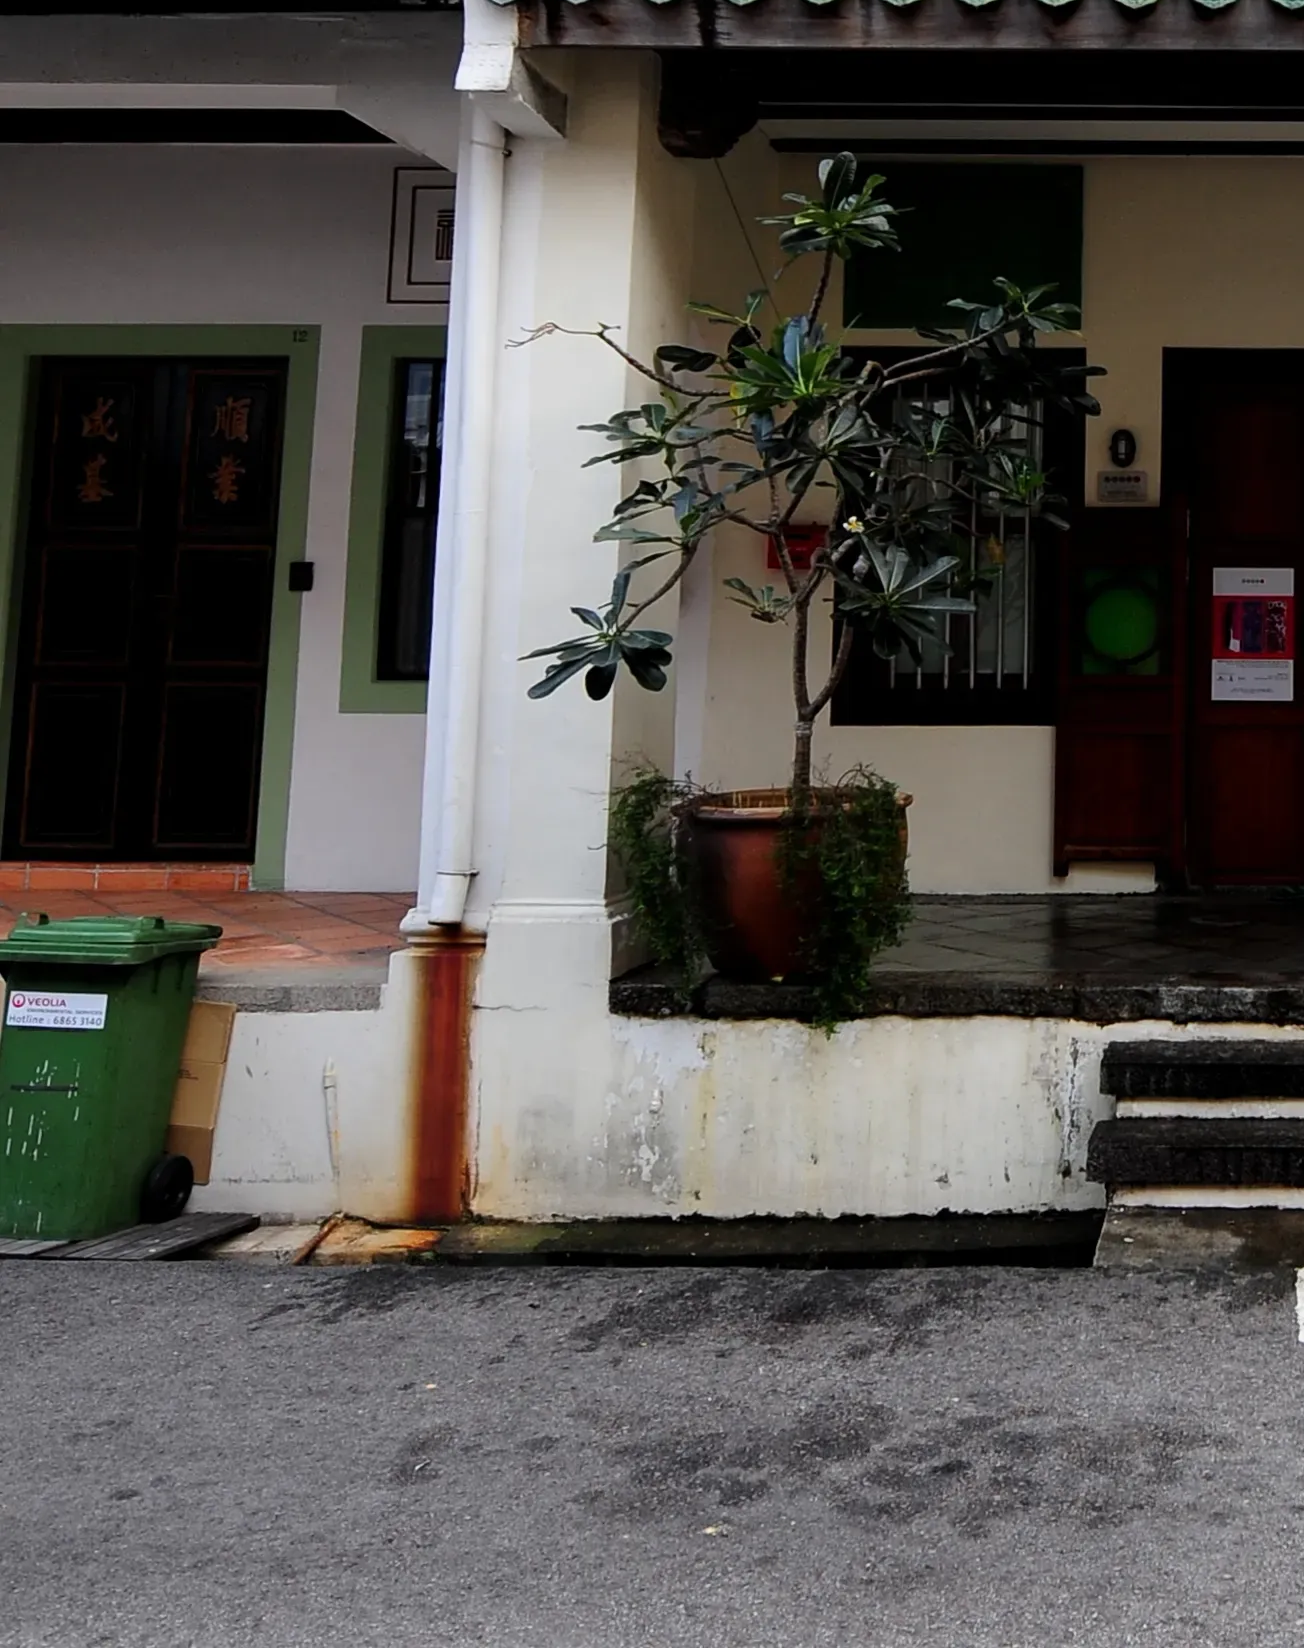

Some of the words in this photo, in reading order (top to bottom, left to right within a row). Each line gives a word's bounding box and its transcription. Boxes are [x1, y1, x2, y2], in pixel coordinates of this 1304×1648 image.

[293, 330, 308, 343] 12
[28, 998, 67, 1007] VEOLIA
[9, 1015, 44, 1023] Hotline
[53, 1016, 77, 1025] 6865
[80, 1016, 102, 1026] 3140
